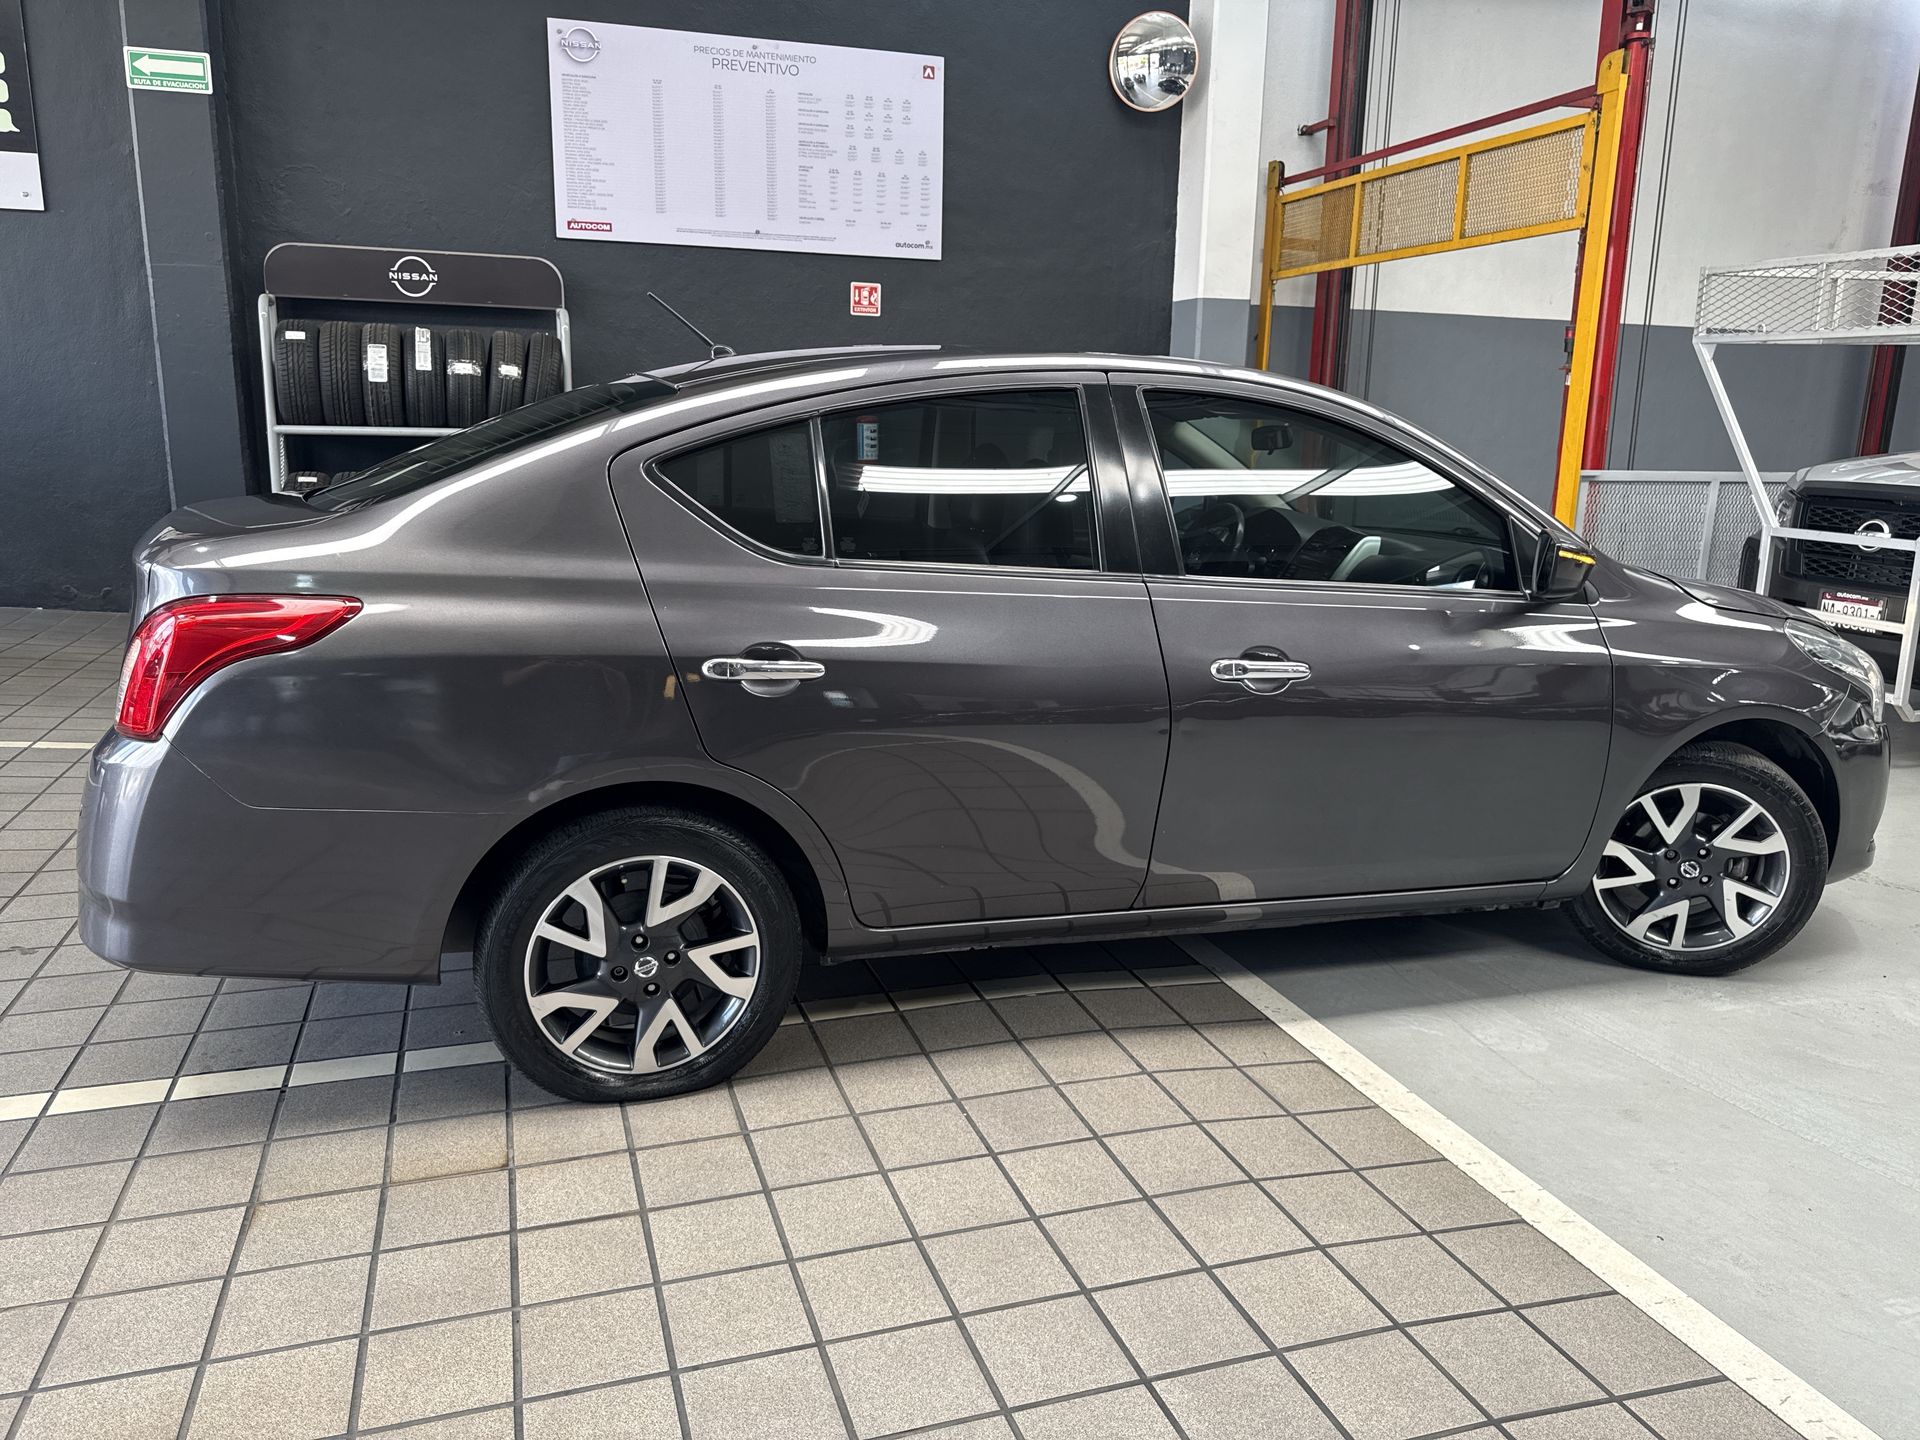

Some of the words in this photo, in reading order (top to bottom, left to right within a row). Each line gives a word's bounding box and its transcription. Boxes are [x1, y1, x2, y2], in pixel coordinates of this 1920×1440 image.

[561, 39, 601, 49] NISSAN
[693, 45, 731, 57] PRECIOS
[732, 49, 745, 58] DE
[746, 50, 817, 64] MANTENIMIENTO
[712, 57, 800, 76] PREVENTIVO
[569, 222, 611, 231] AUTOCOM
[388, 271, 438, 282] NISSAN
